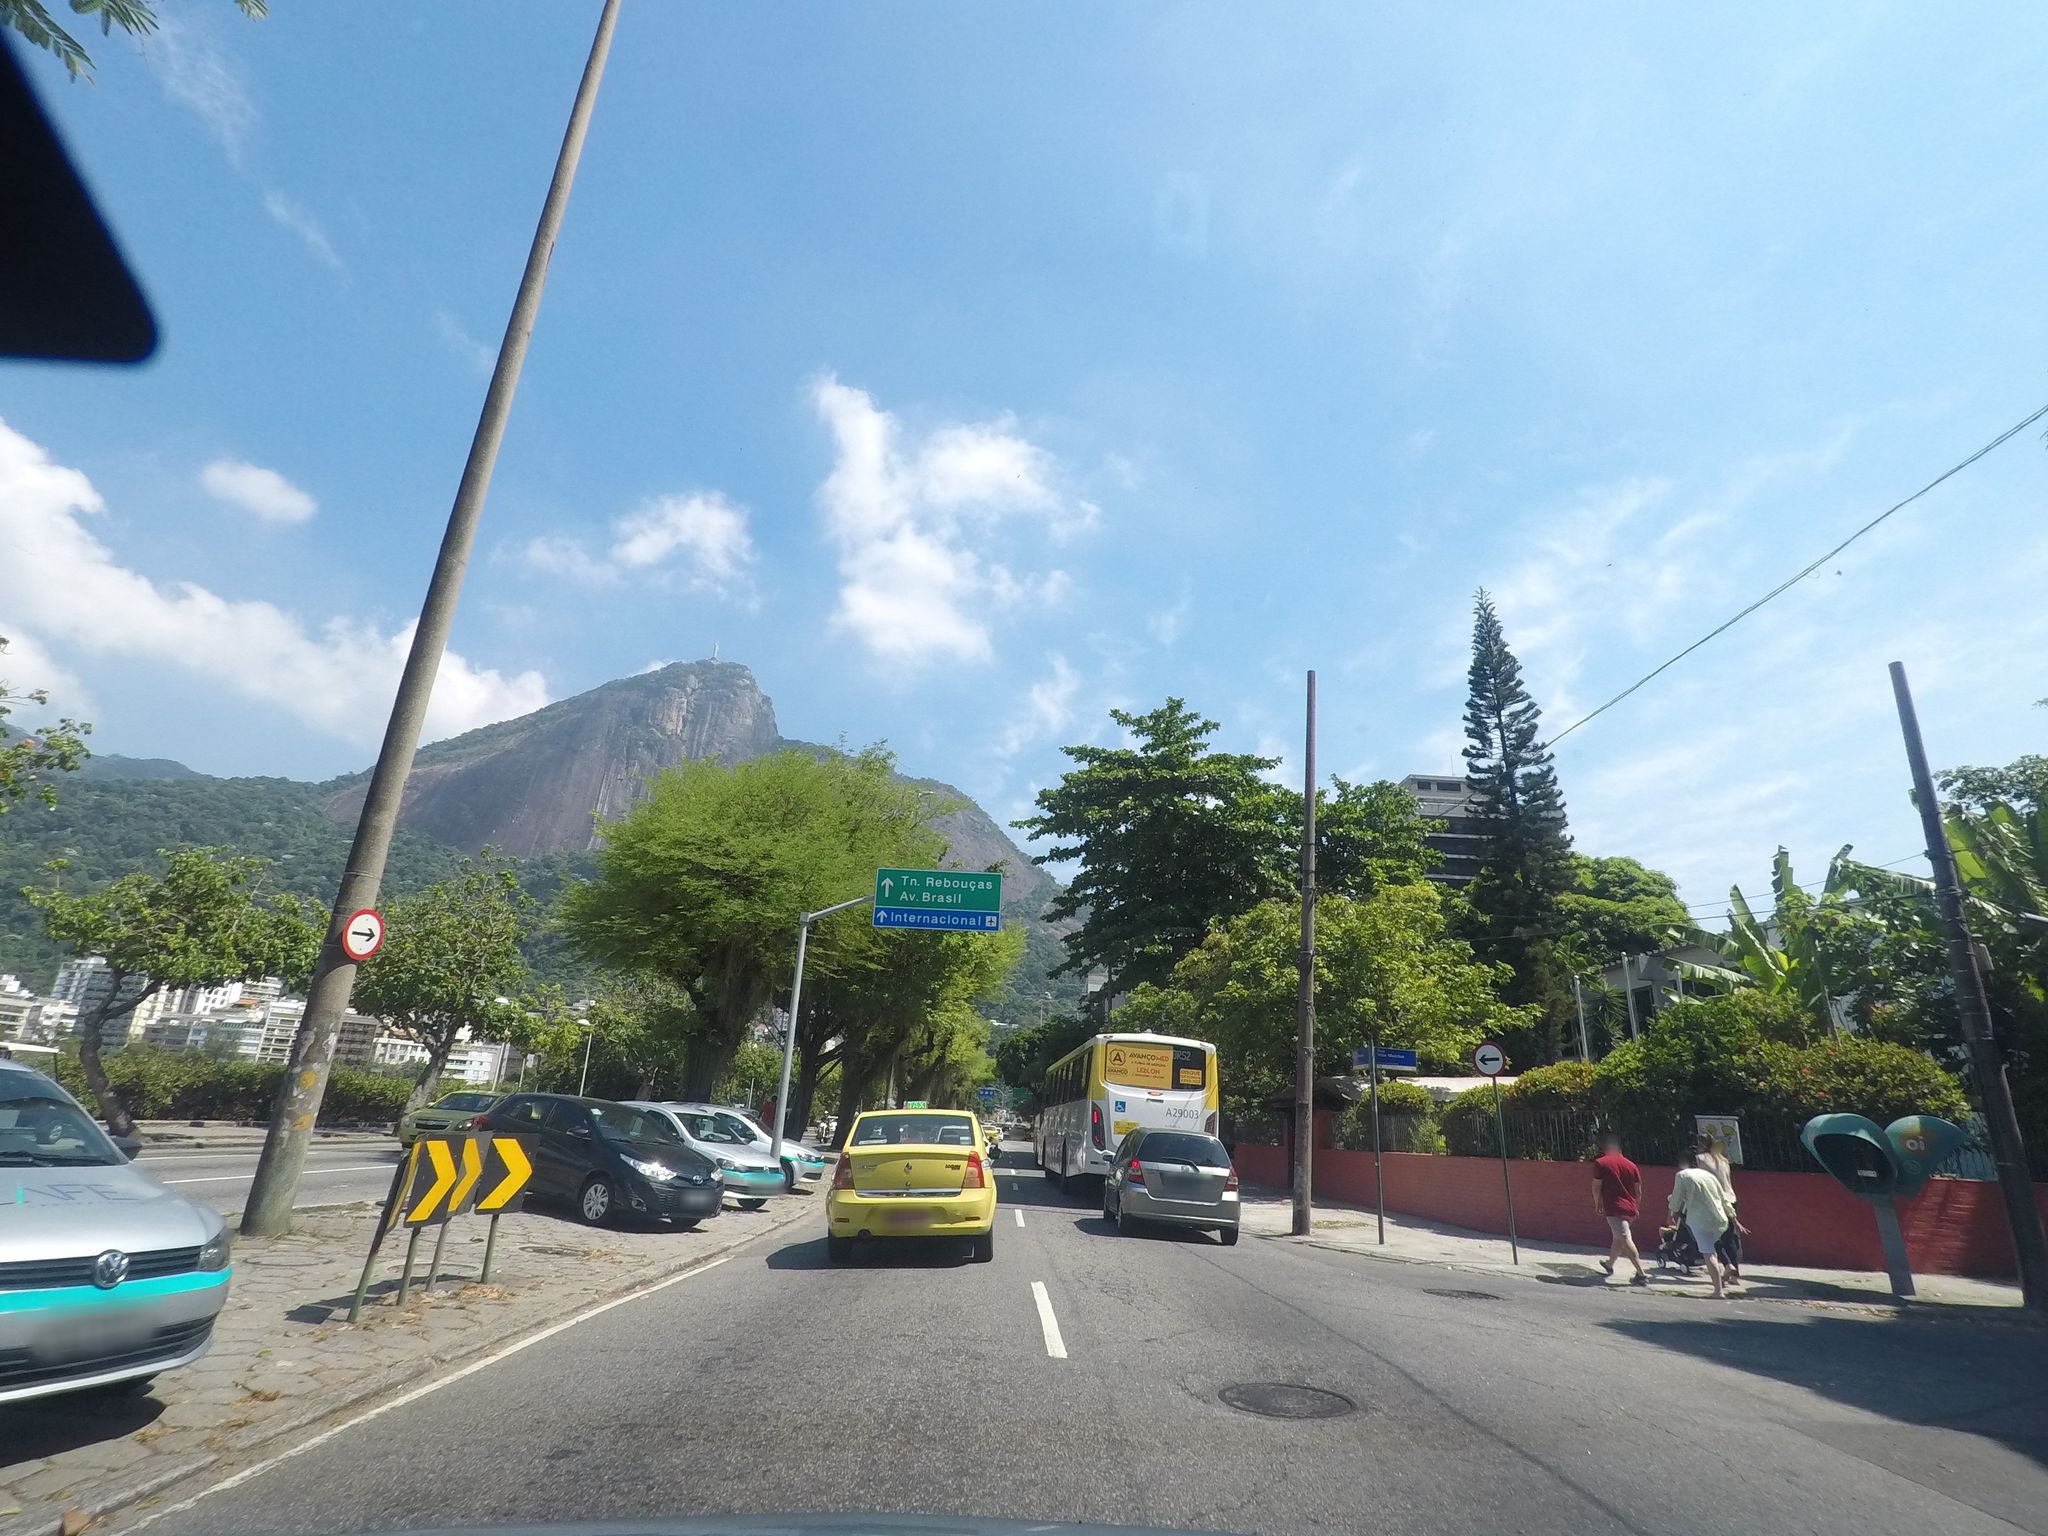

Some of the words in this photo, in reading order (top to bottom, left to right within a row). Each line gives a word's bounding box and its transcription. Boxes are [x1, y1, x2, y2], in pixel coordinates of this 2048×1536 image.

[901, 875, 920, 887] Tn.
[926, 876, 993, 891] Rebouças
[899, 891, 919, 902] Av.
[922, 892, 962, 904] Brasil
[890, 912, 981, 926] Internacional
[908, 1101, 928, 1109] TAXI
[1165, 1108, 1199, 1119] A29003
